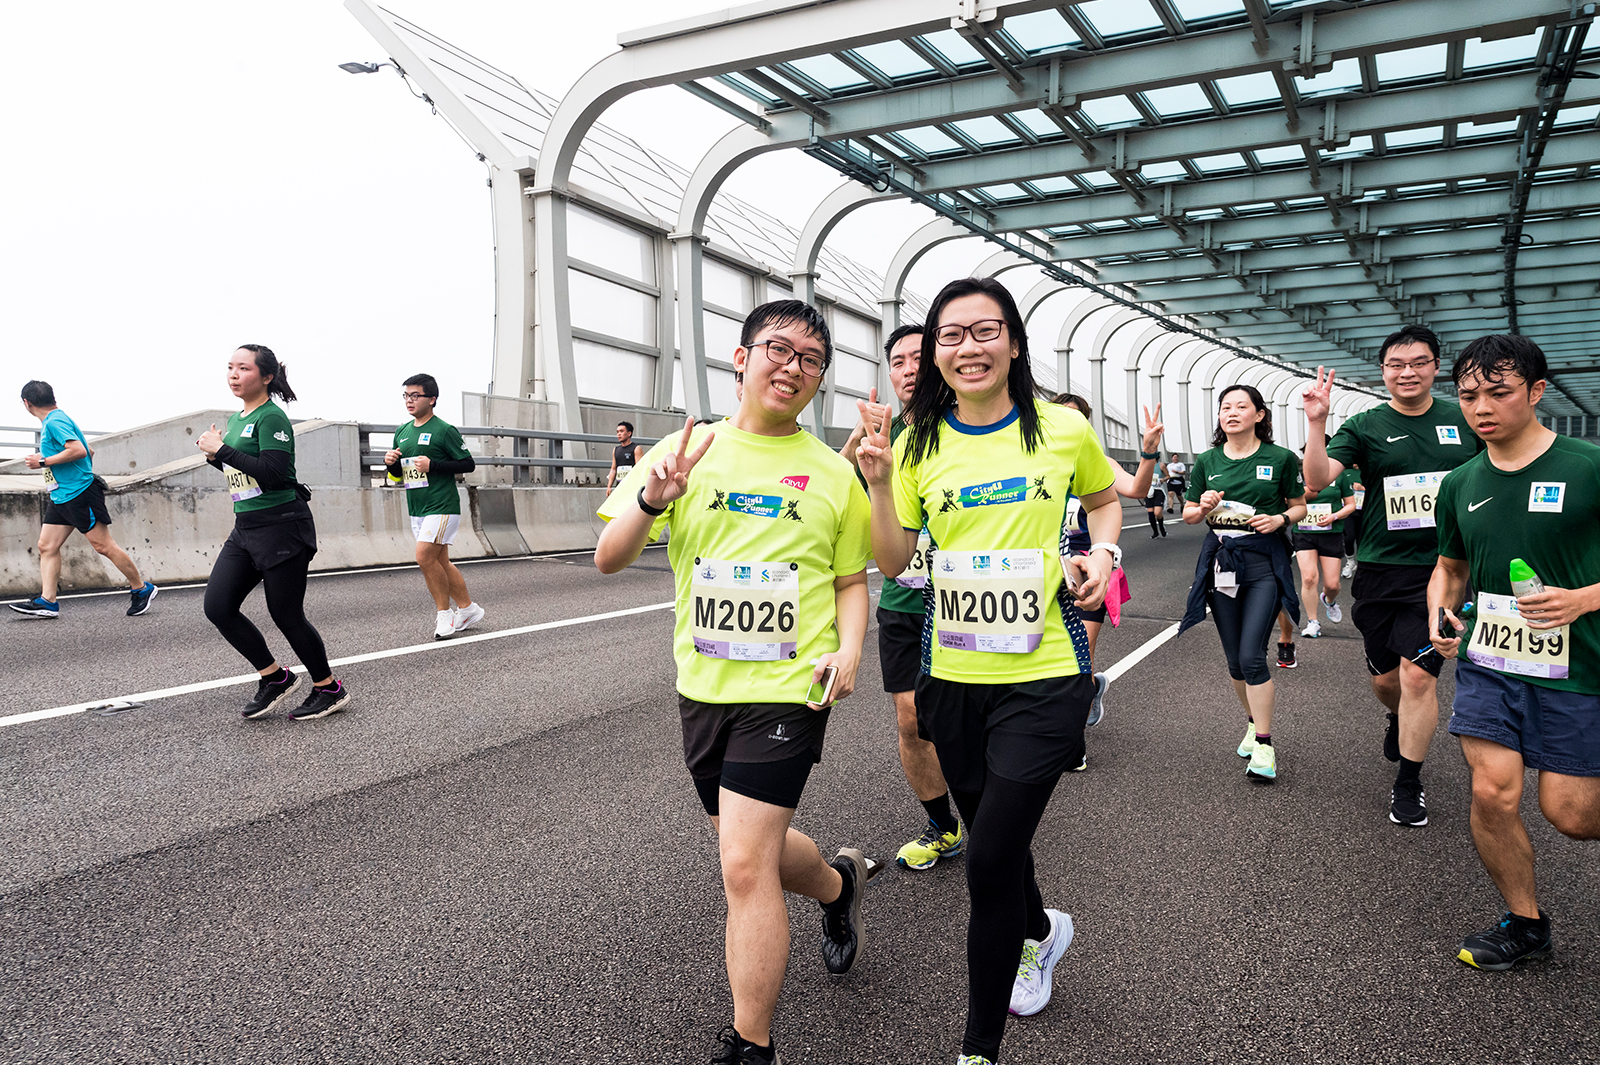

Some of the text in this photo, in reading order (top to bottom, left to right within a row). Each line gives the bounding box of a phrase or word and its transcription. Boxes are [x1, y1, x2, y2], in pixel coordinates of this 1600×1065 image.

[782, 478, 804, 488] CityU
[970, 481, 1003, 499] CityU
[736, 495, 763, 506] CityU
[978, 490, 1019, 504] Runner
[1390, 494, 1437, 514] M16
[741, 504, 774, 513] Runner
[695, 596, 795, 632] M2026
[940, 589, 1040, 623] M2003
[1477, 622, 1563, 656] M2199
